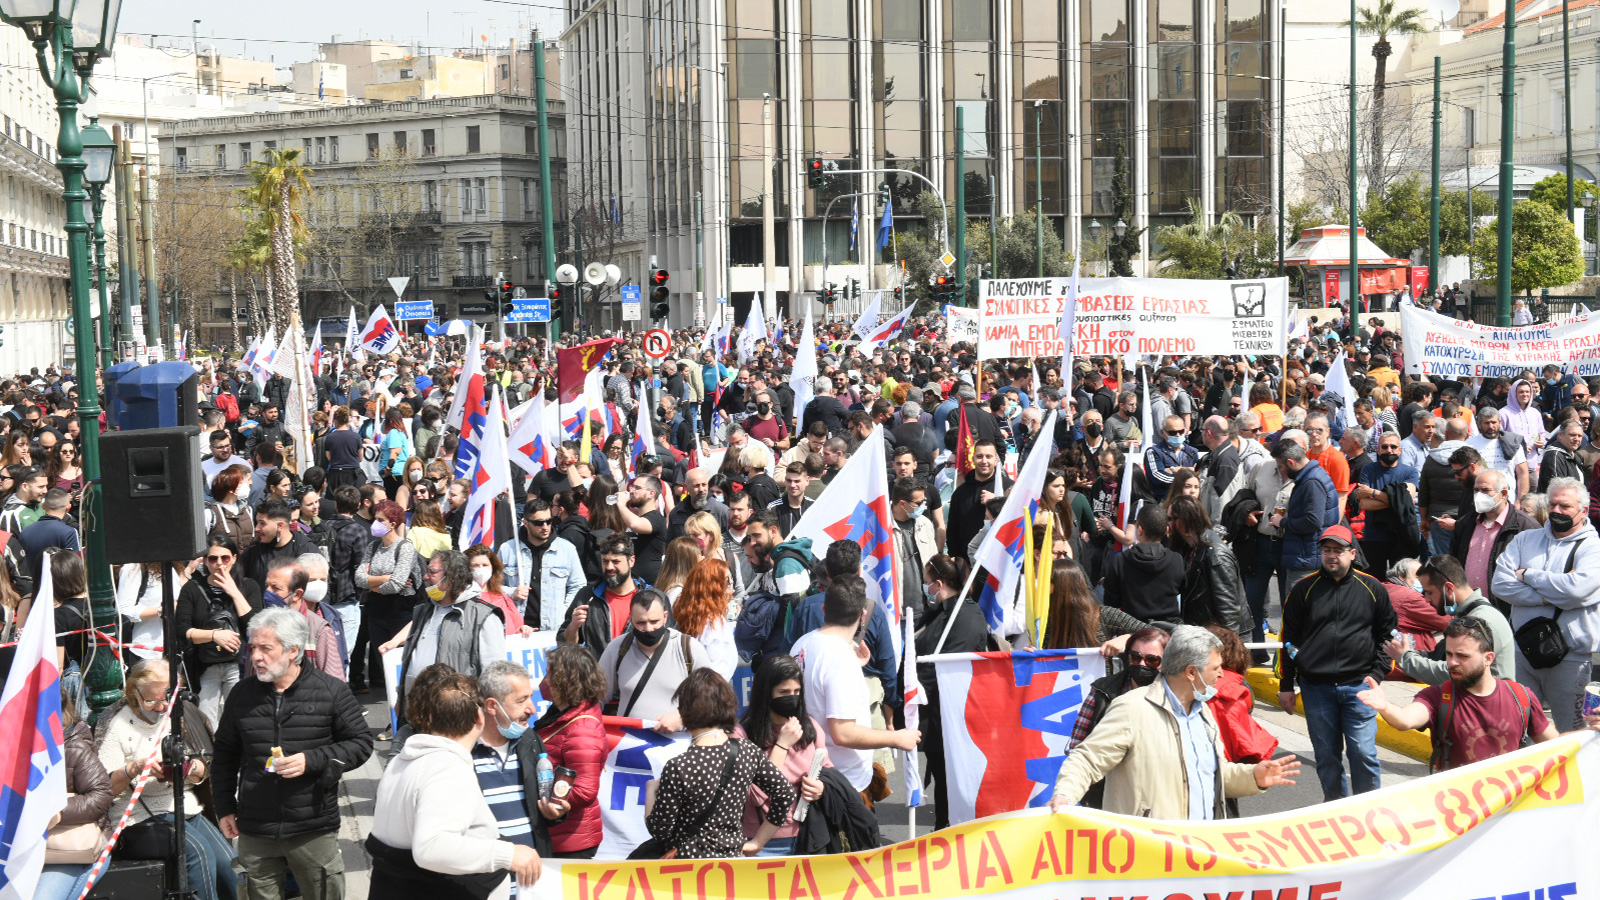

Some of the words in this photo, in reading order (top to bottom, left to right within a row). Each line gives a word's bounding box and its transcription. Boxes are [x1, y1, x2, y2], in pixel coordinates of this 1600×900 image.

[988, 280, 1052, 297] ΠΑΛΕΥΟΥΜΕ
[1056, 294, 1135, 314] ΣΜΒΑΣΕΙΣ
[1143, 296, 1211, 315] ΕΡΓΑΣΙΑΣ
[985, 325, 1020, 341] ΚΑΜΙΑ
[1029, 323, 1100, 340] ΕΜΠΚΗ
[1232, 320, 1273, 328] ΣΩΜΑΤΕΙΟ
[1010, 339, 1130, 356] ΙΜΠΕΡΙΑΙΣΤΙΚΟ
[1138, 337, 1196, 353] ΠΟΛΕΜΟ
[1233, 340, 1273, 350] ΤΕΧΝΙΚΩΝ
[1424, 345, 1485, 360] ΚΑΤΟΧΥΡΩΣΗ
[1492, 352, 1510, 361] ΤΗΣ
[1515, 351, 1562, 361] ΚΥΡΙΑΚΗΣ
[1517, 340, 1559, 351] ΣΤΑΘΕΡΗ
[1422, 361, 1471, 376] ΣΥΛΛΟΓΟΣ
[842, 830, 1014, 900] ΧΕΡΙΑ
[1031, 828, 1136, 879] ΑΠΟ
[1151, 829, 1219, 872] ΤΟ
